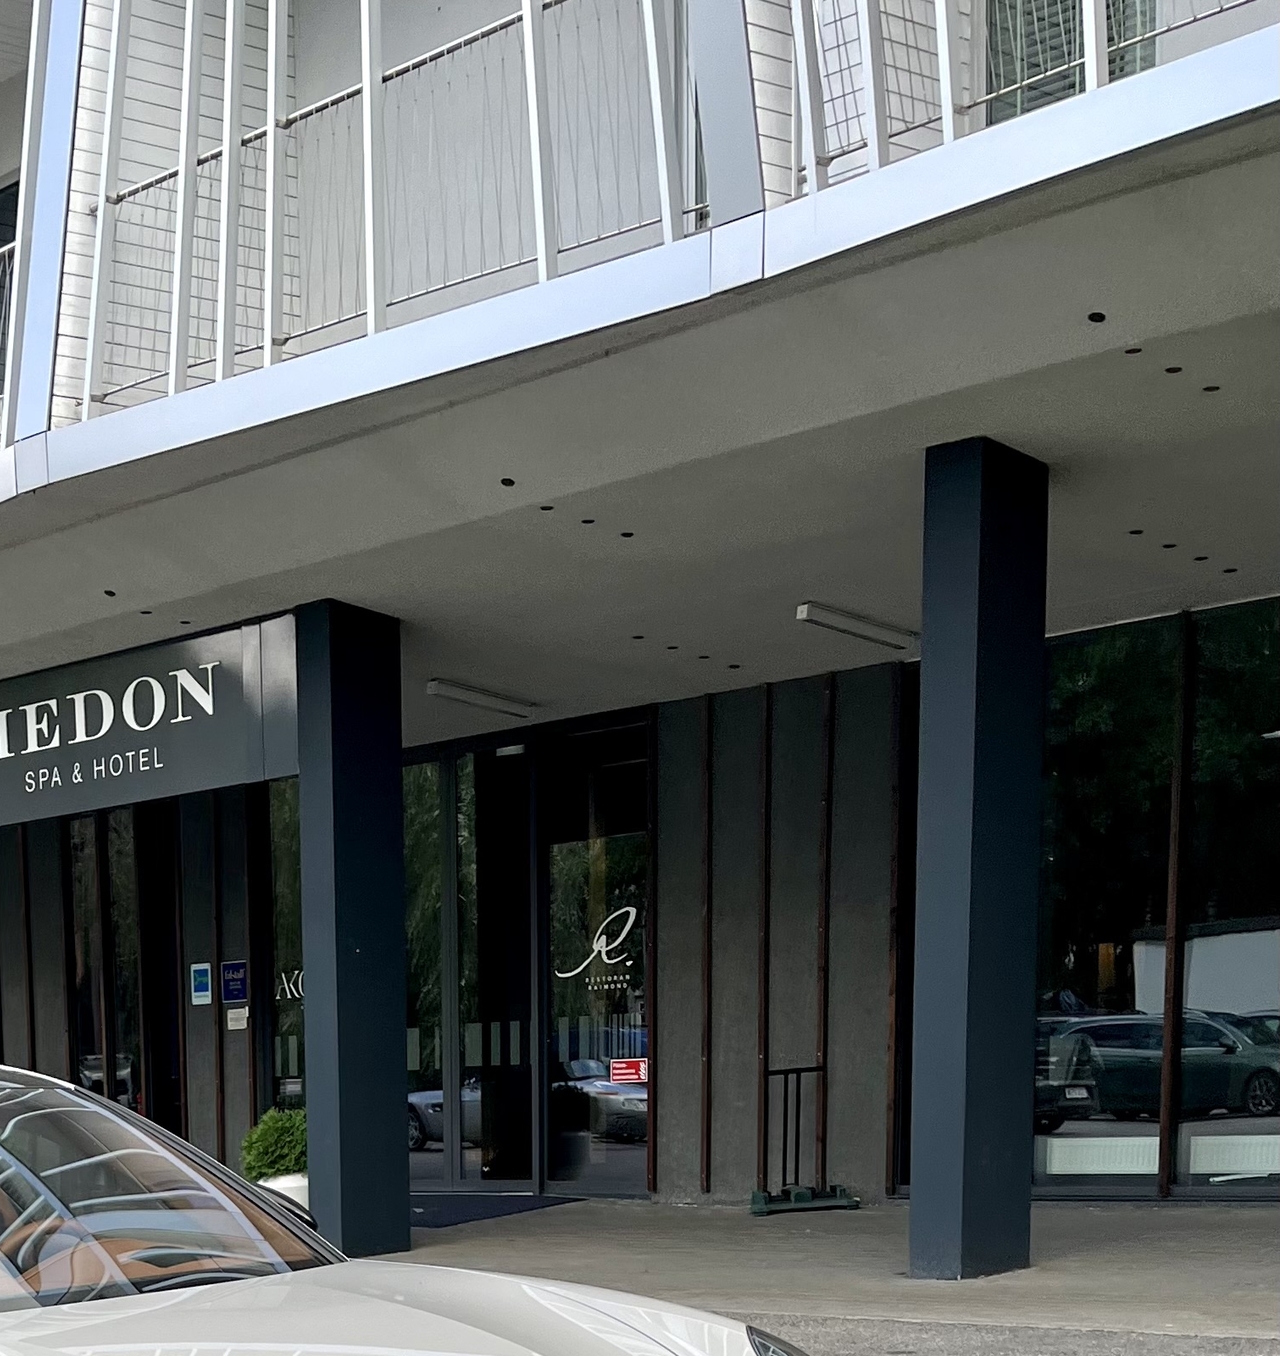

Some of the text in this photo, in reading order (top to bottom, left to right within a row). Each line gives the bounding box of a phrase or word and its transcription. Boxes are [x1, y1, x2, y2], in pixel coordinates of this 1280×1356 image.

[24, 746, 164, 793] SPA & HOTEL
[585, 974, 631, 984] RESTORAN
[587, 982, 628, 991] RAIMOND
